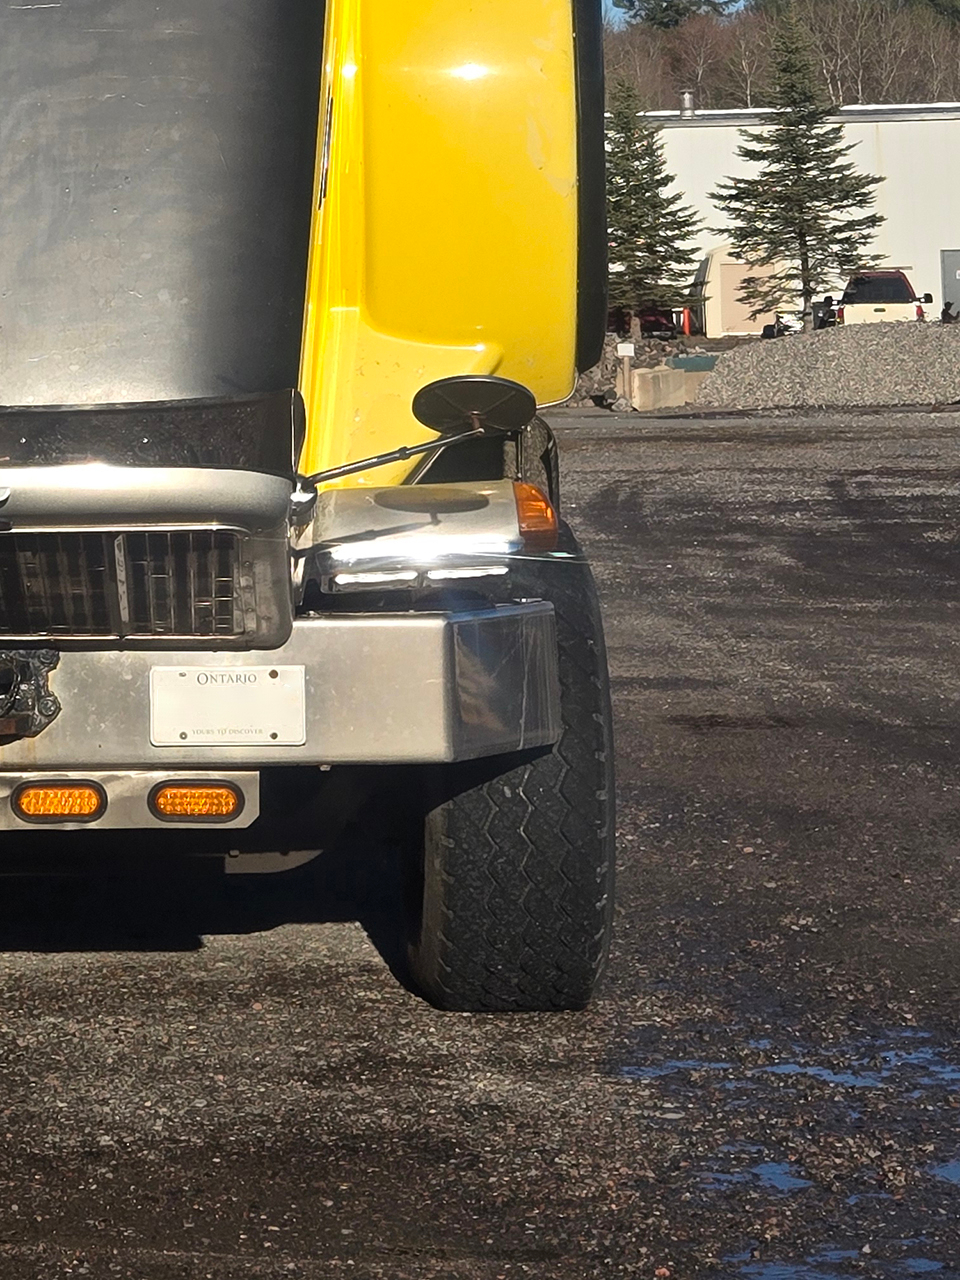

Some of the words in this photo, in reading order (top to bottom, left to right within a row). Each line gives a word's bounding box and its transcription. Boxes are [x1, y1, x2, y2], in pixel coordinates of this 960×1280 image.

[196, 672, 258, 686] ONTARIO
[191, 728, 214, 736] YOURS
[217, 728, 227, 736] TO
